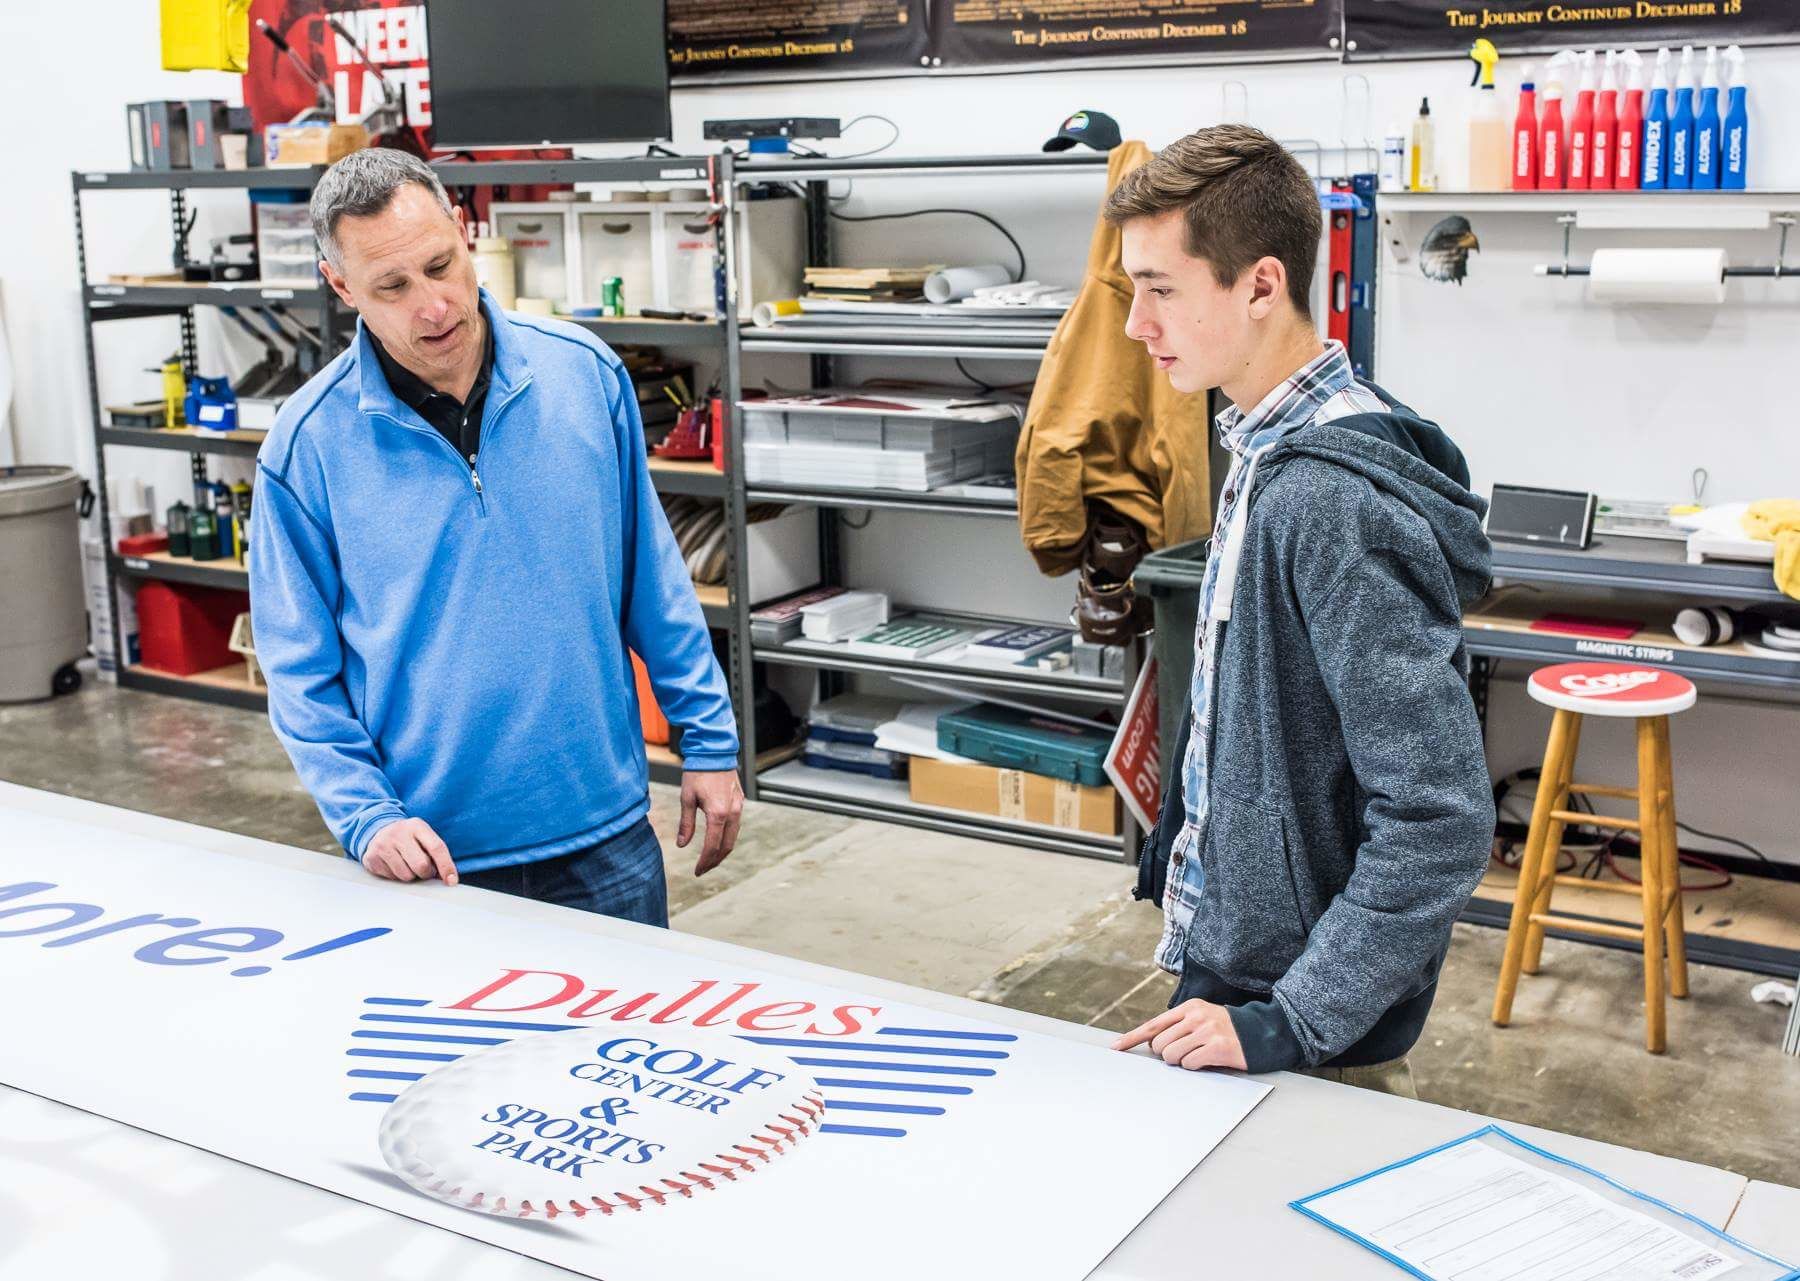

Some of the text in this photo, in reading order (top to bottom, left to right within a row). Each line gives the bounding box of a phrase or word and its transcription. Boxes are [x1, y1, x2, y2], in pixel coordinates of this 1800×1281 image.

[1722, 0, 1742, 15] 18
[1644, 120, 1662, 183] WINDEX
[1674, 129, 1686, 176] ALCOHOL
[1699, 128, 1711, 175] ALCOHOL
[1729, 126, 1742, 173] ALCOHOL
[1576, 641, 1674, 662] MAGNETIC STRIPS
[438, 968, 883, 1036] Dulles
[569, 1062, 732, 1115] CENTER
[596, 1037, 787, 1095] GOLF
[480, 1103, 666, 1165] SPORTS
[580, 1096, 640, 1126] &
[472, 1131, 605, 1179] PARK
